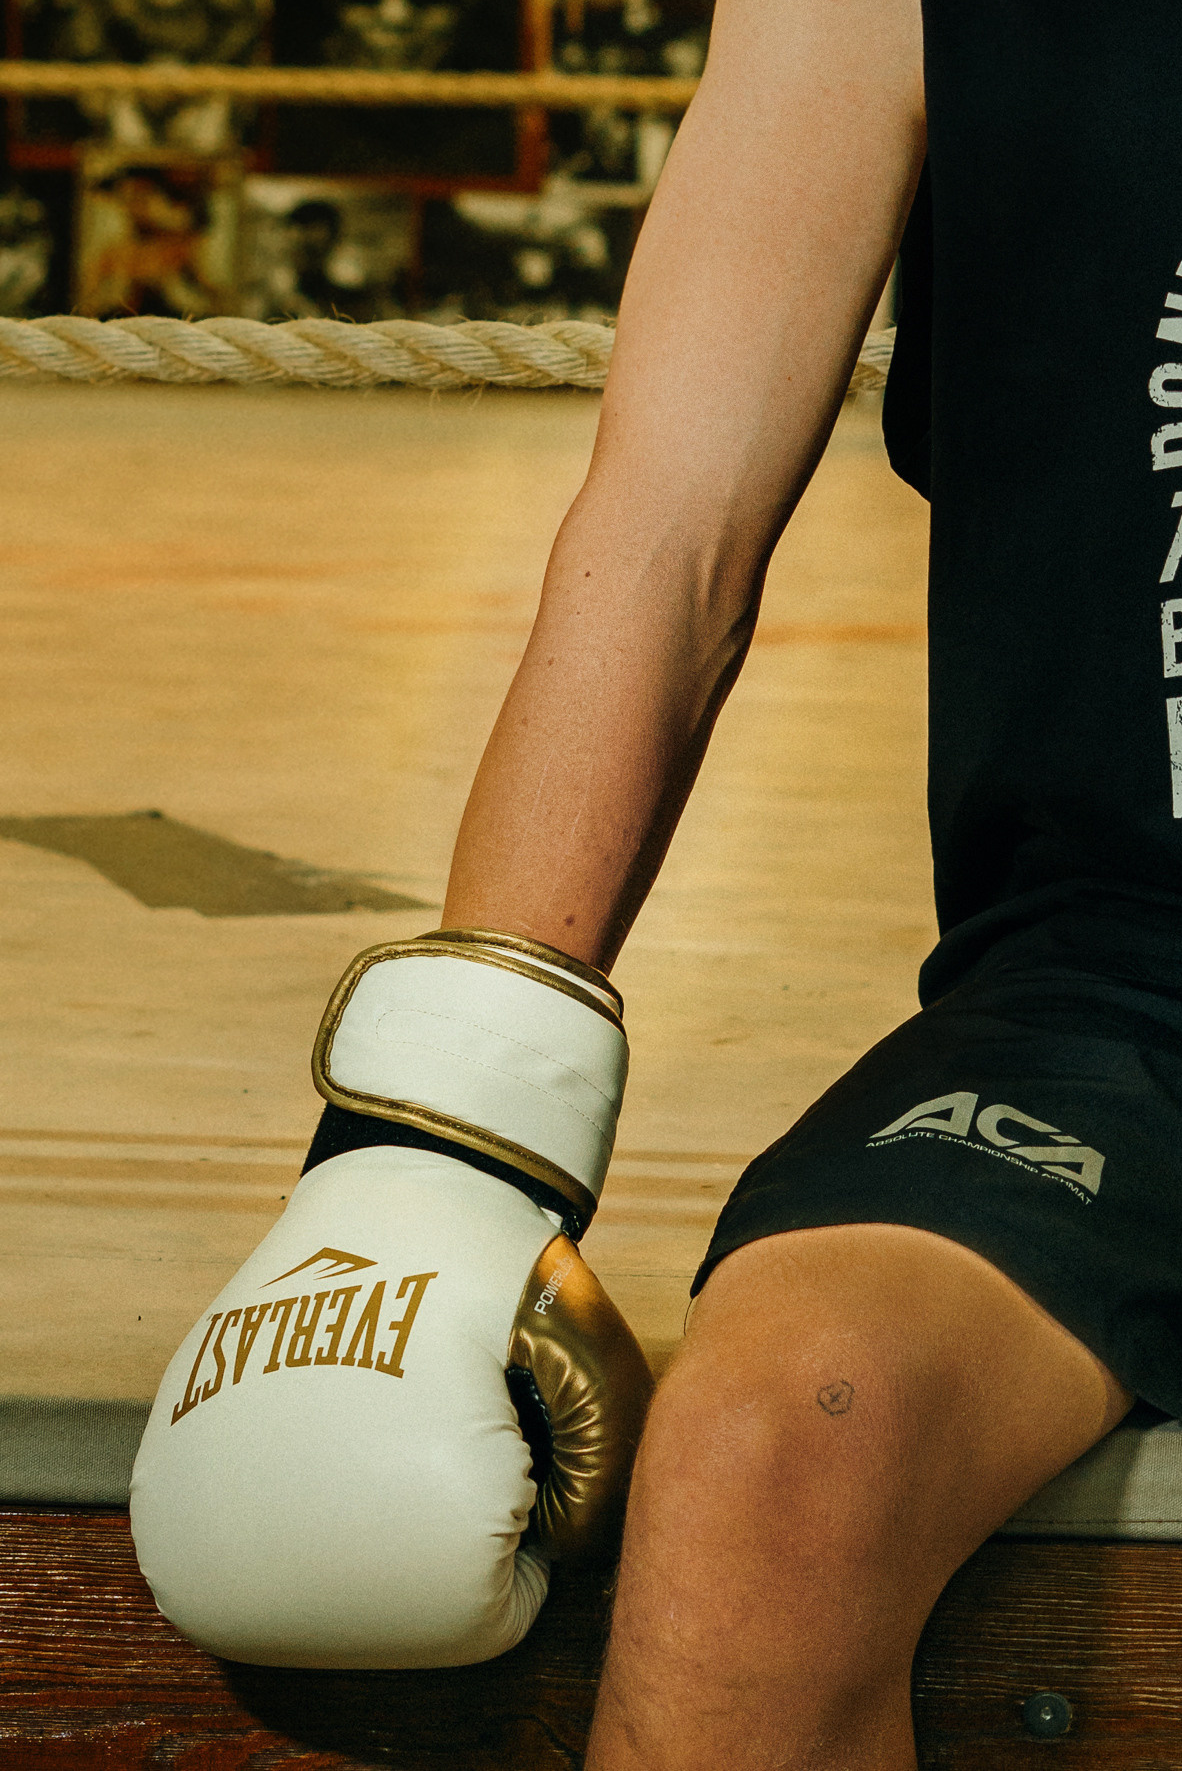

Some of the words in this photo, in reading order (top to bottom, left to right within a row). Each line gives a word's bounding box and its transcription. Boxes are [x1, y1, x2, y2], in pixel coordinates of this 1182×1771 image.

[865, 1130, 935, 1148] ABSOLUTE
[938, 1133, 1039, 1174] CHAMPIONSHIP
[1041, 1171, 1093, 1206] AKHMAT
[169, 1270, 439, 1428] EVERLAST
